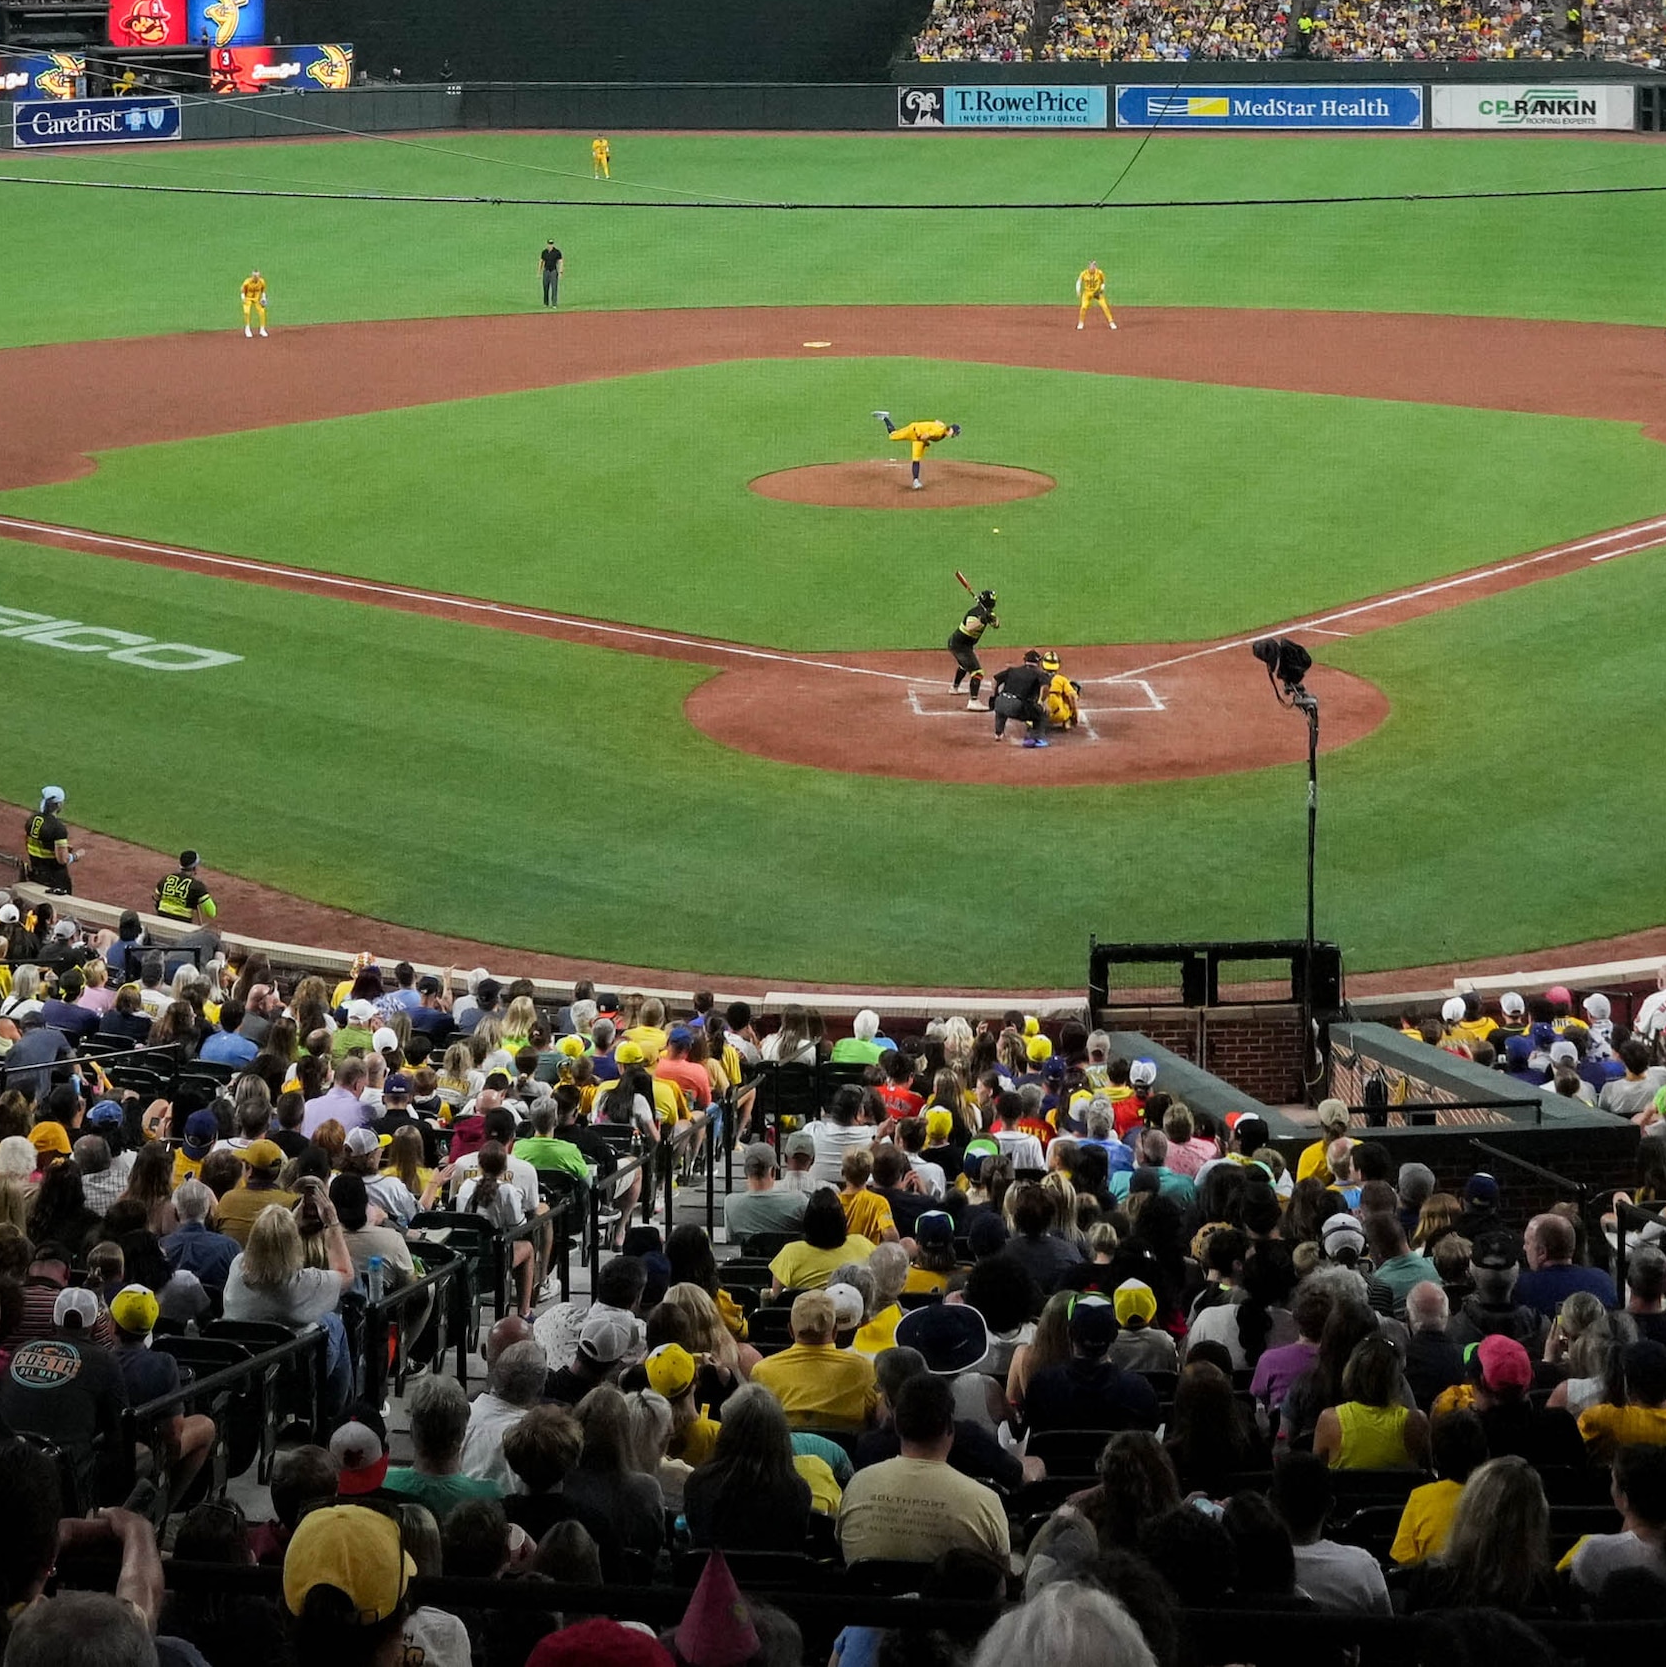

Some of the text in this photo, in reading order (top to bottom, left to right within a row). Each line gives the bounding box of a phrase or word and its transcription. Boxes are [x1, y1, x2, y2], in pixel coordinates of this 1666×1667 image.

[1233, 99, 1390, 117] MedStar Health
[163, 874, 193, 898] 24
[14, 1353, 76, 1374] COSTA
[19, 1367, 59, 1380] DEL MAR
[870, 1493, 947, 1509] SOUTHPORT
